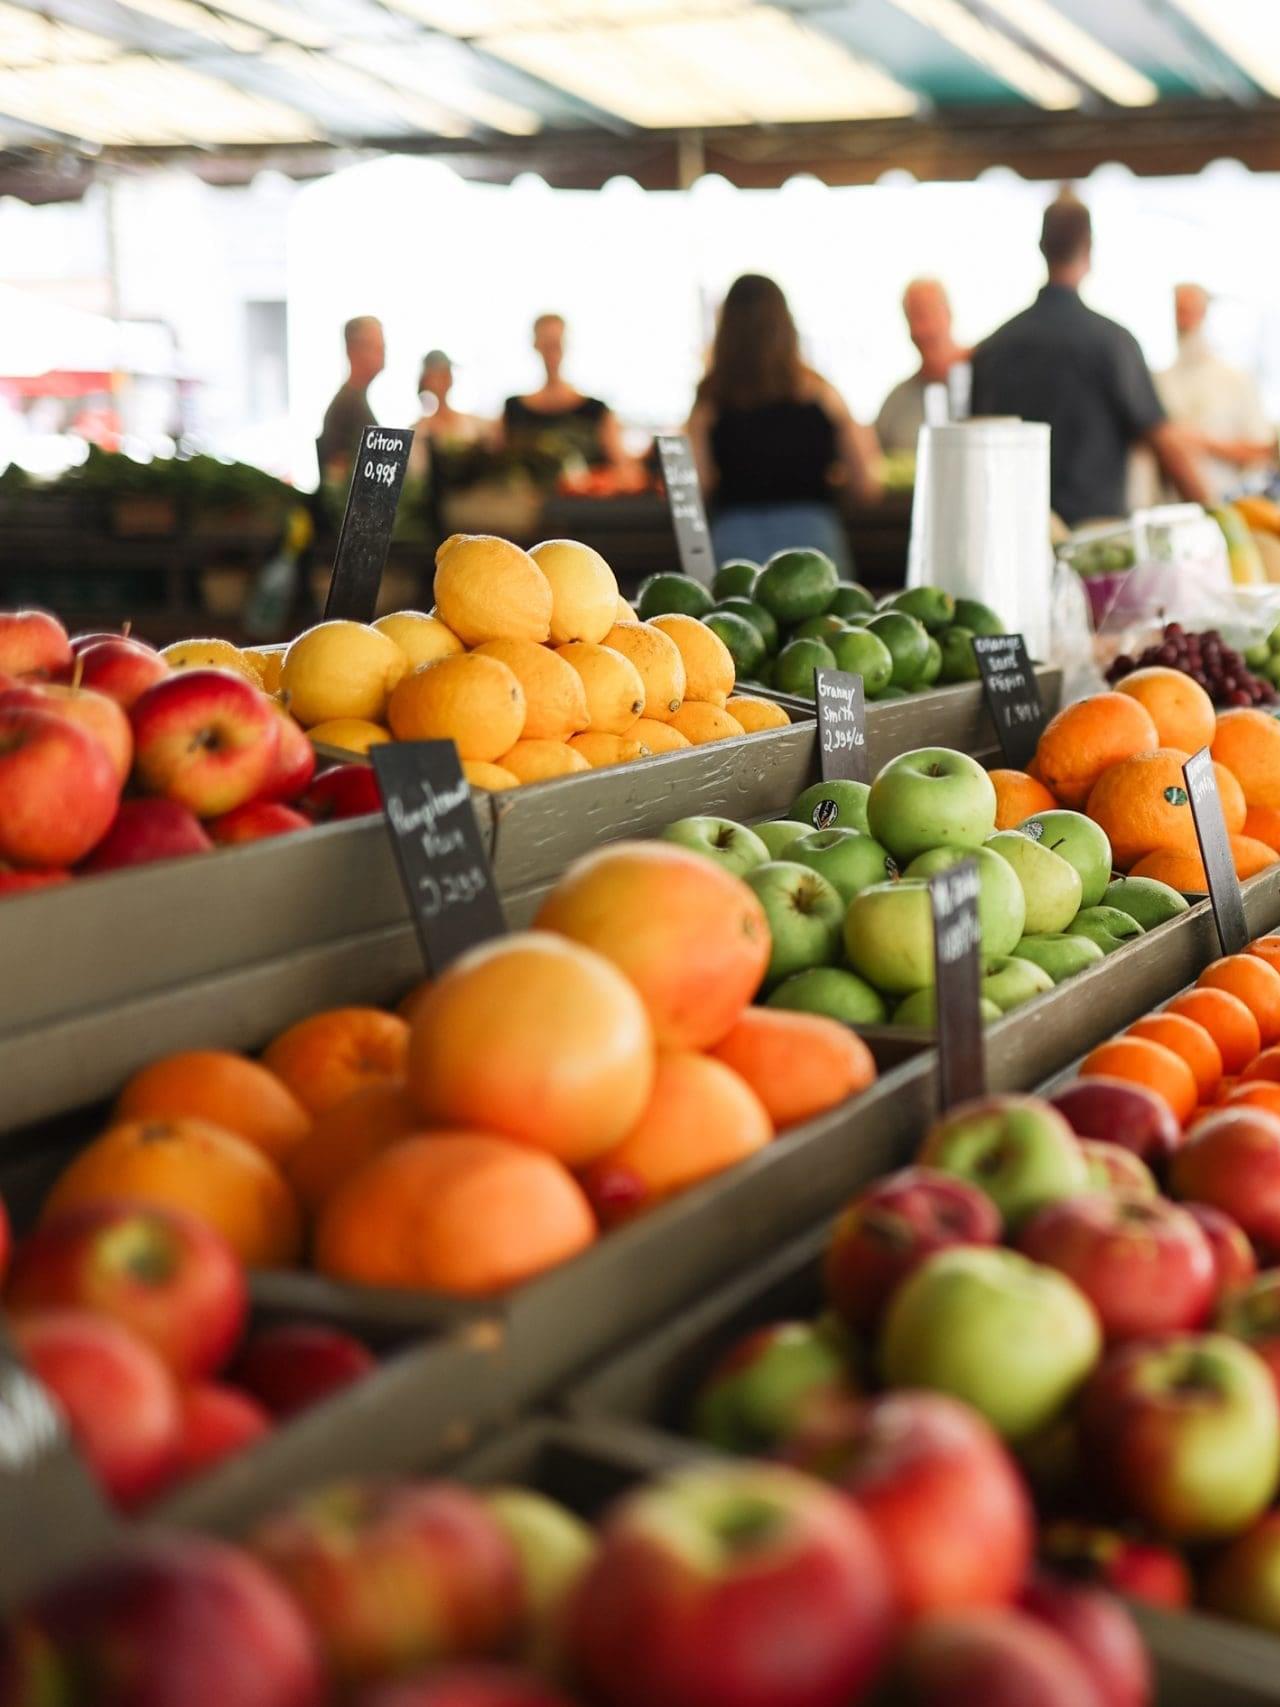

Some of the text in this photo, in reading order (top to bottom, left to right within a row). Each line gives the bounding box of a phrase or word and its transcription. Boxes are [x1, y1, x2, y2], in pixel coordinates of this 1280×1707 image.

[366, 431, 404, 451] Citron
[818, 673, 855, 711] Granny
[823, 705, 855, 723] Smith
